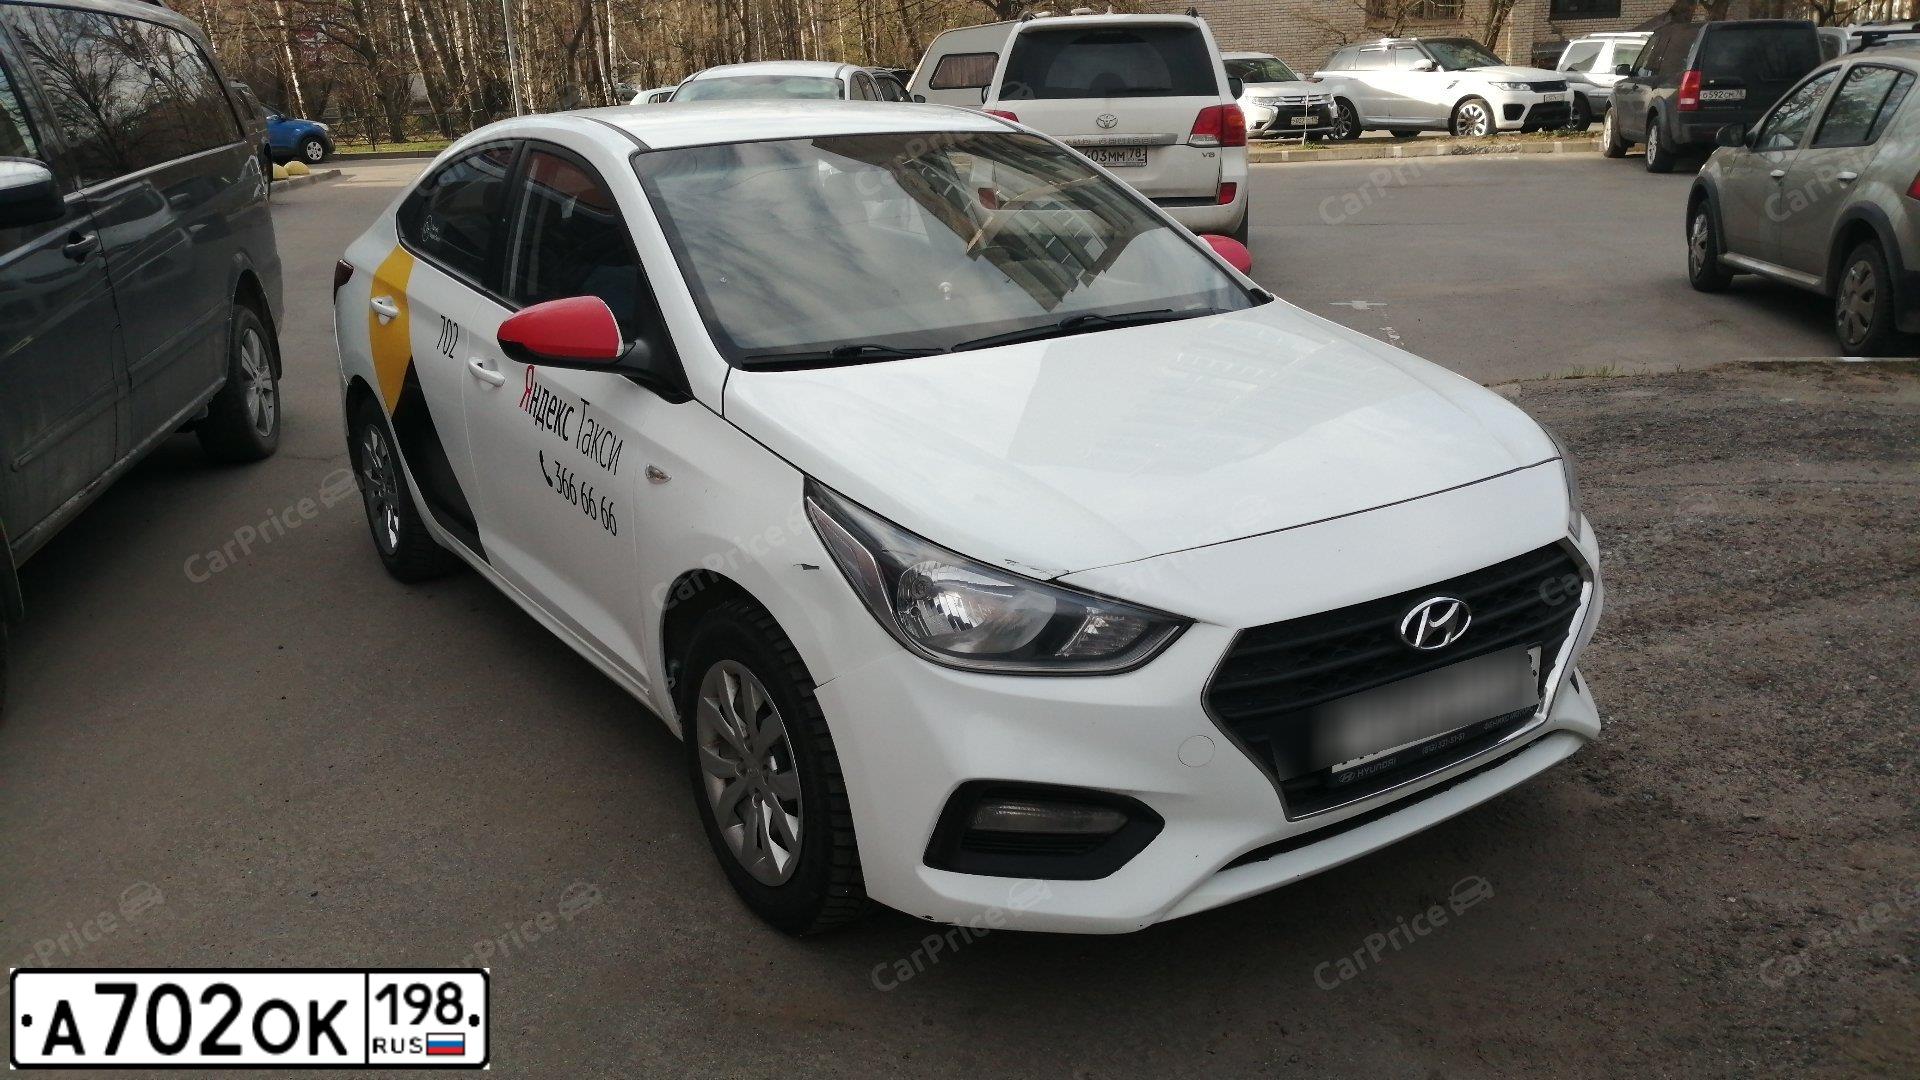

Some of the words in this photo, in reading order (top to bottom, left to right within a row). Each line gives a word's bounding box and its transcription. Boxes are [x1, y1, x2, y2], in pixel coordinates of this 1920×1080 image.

[437, 315, 459, 359] 702
[519, 365, 575, 441] Яндекс
[576, 397, 624, 476] Такси
[555, 460, 577, 506] 366
[581, 481, 597, 521] 66
[601, 496, 617, 537] 66
[1357, 758, 1397, 778] HYUNDAI
